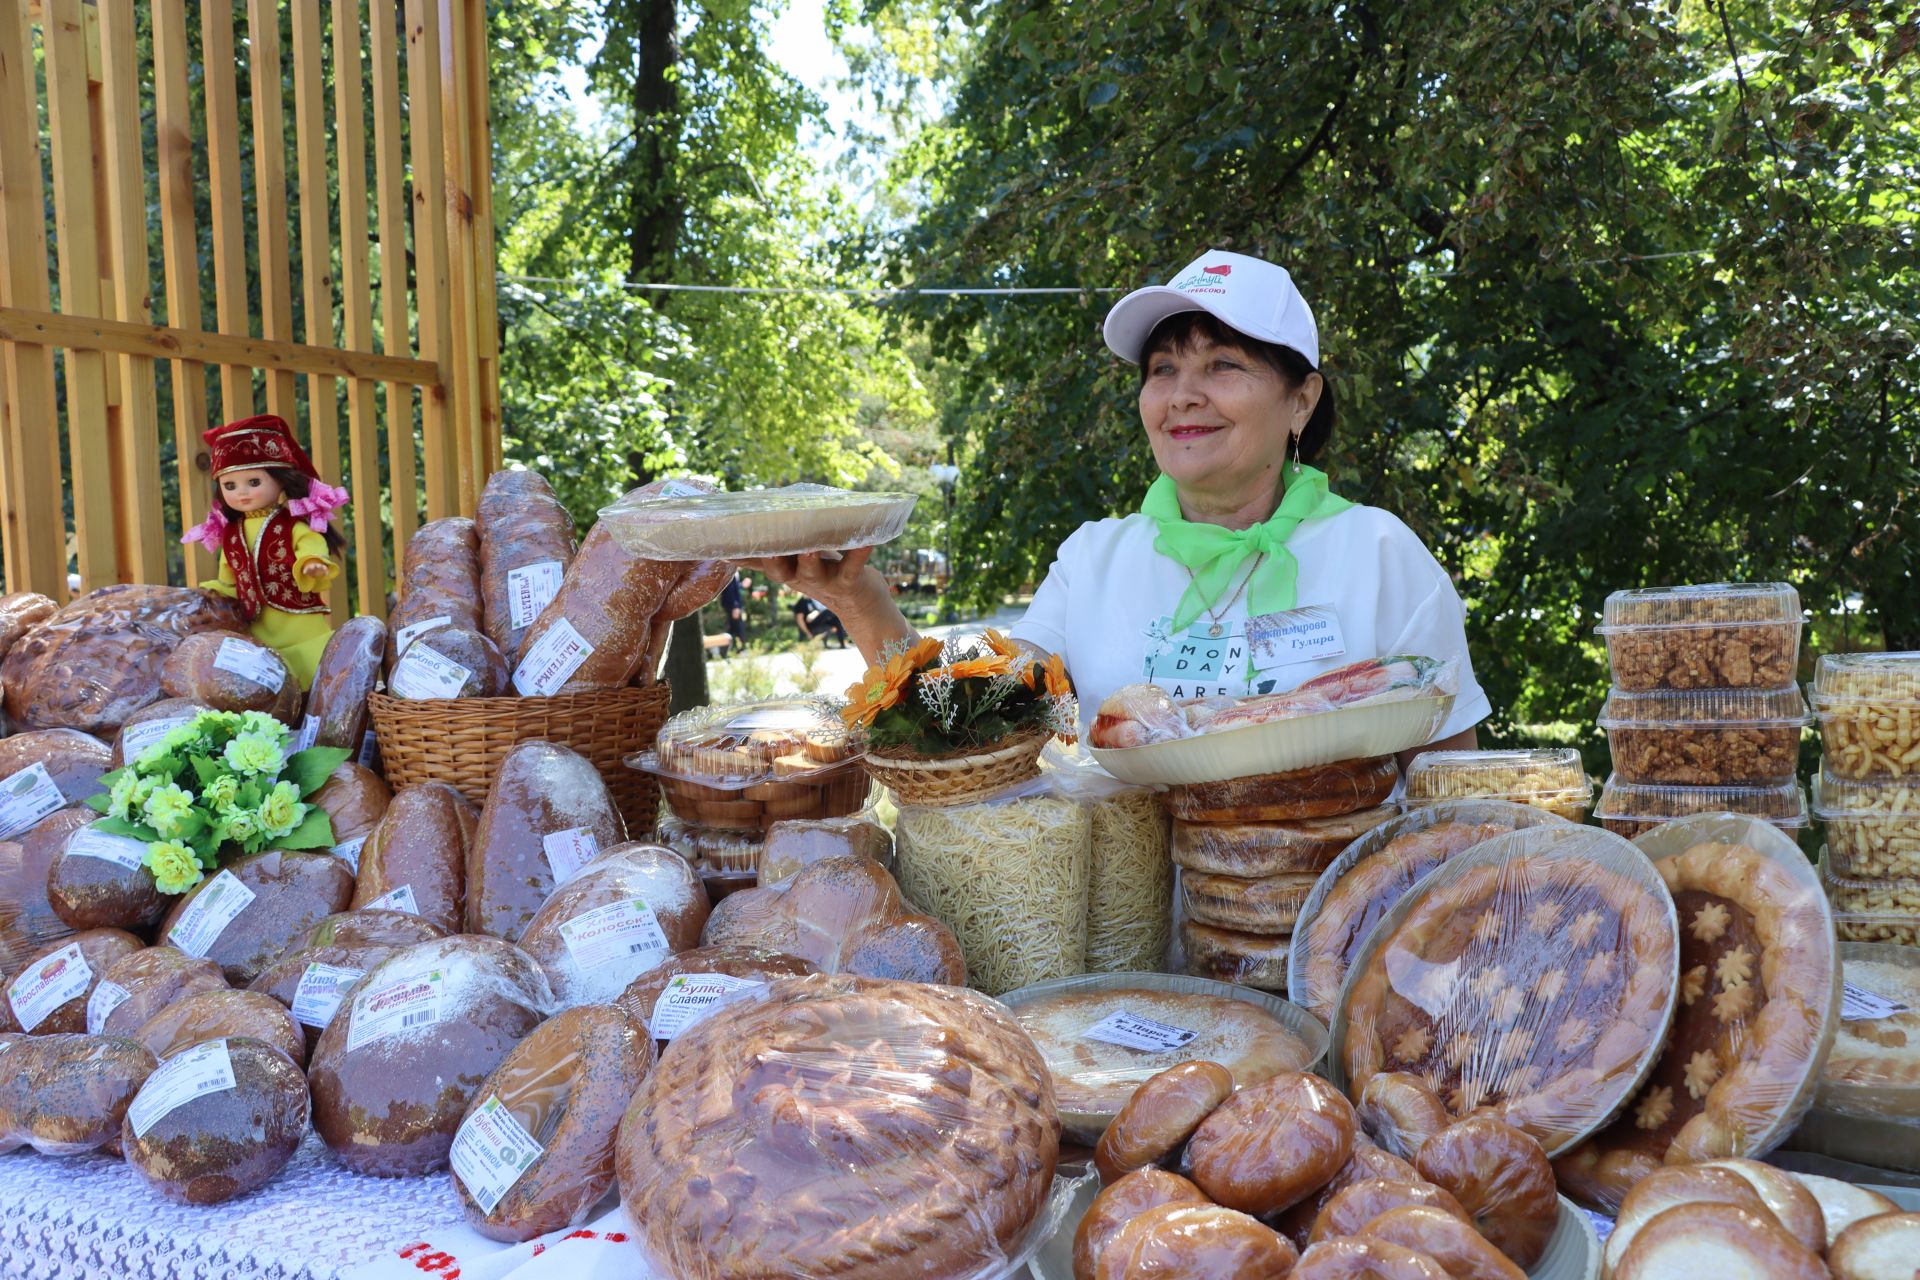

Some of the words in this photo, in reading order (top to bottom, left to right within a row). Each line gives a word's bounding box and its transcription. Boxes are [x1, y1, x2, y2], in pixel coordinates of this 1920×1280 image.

[1291, 636, 1335, 650] Гулира
[1181, 644, 1242, 658] MON
[415, 652, 442, 670] Хлеб
[1176, 659, 1235, 675] DAY
[138, 722, 171, 736] Хлеб
[586, 910, 625, 929] Хлеб
[304, 973, 338, 985] Хлеб
[678, 984, 727, 996] Булка
[1131, 1023, 1170, 1038] Пирог
[474, 1114, 502, 1148] Бублики
[479, 1143, 502, 1170] маком
